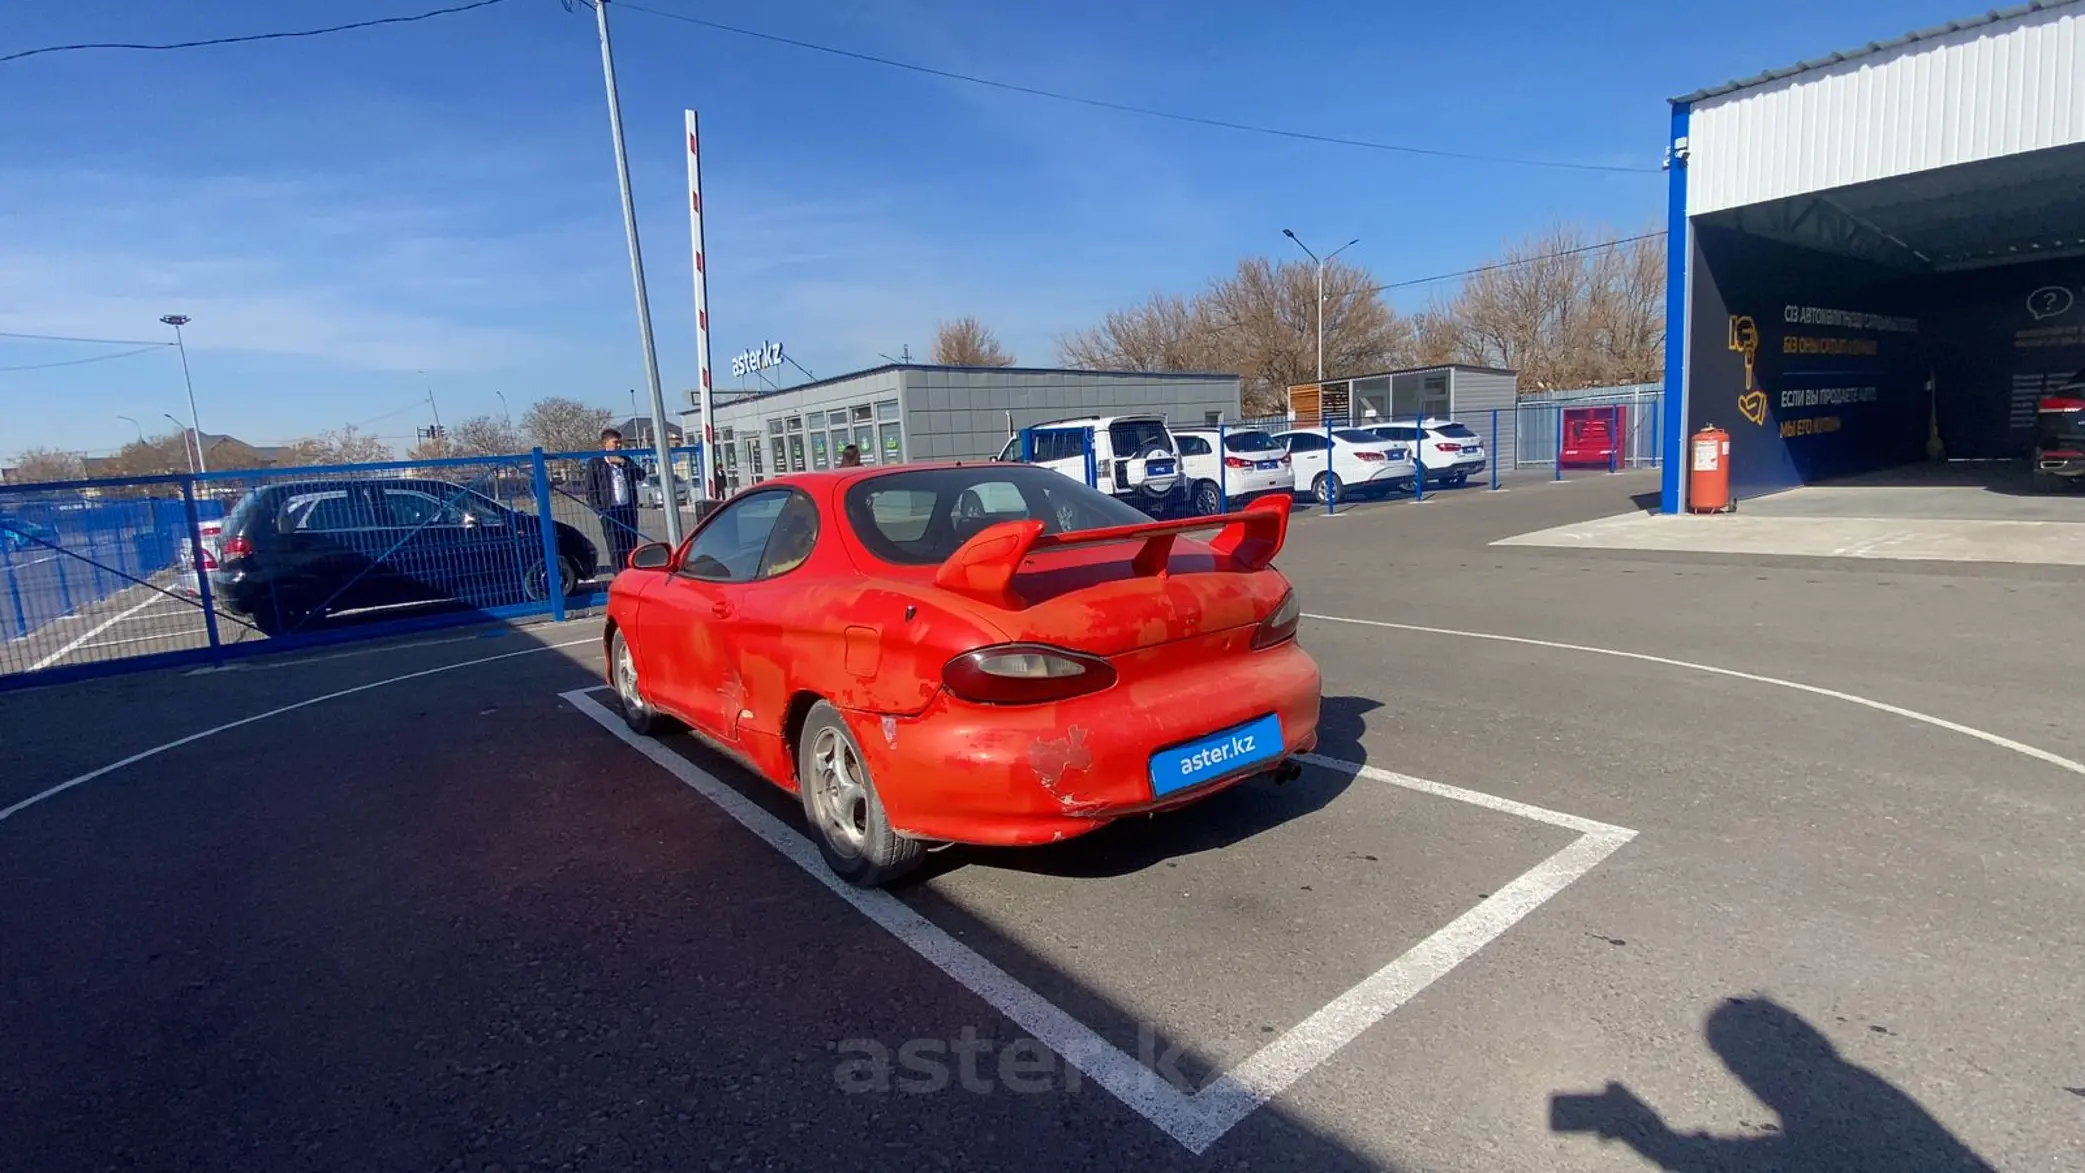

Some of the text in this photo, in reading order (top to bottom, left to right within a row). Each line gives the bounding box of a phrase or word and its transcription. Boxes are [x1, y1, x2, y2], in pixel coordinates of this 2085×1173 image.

[732, 340, 782, 377] aster.kz
[1781, 390, 1804, 408] ЕСЛИ
[1805, 388, 1818, 406] ВЫ
[1180, 735, 1256, 775] aster.kz
